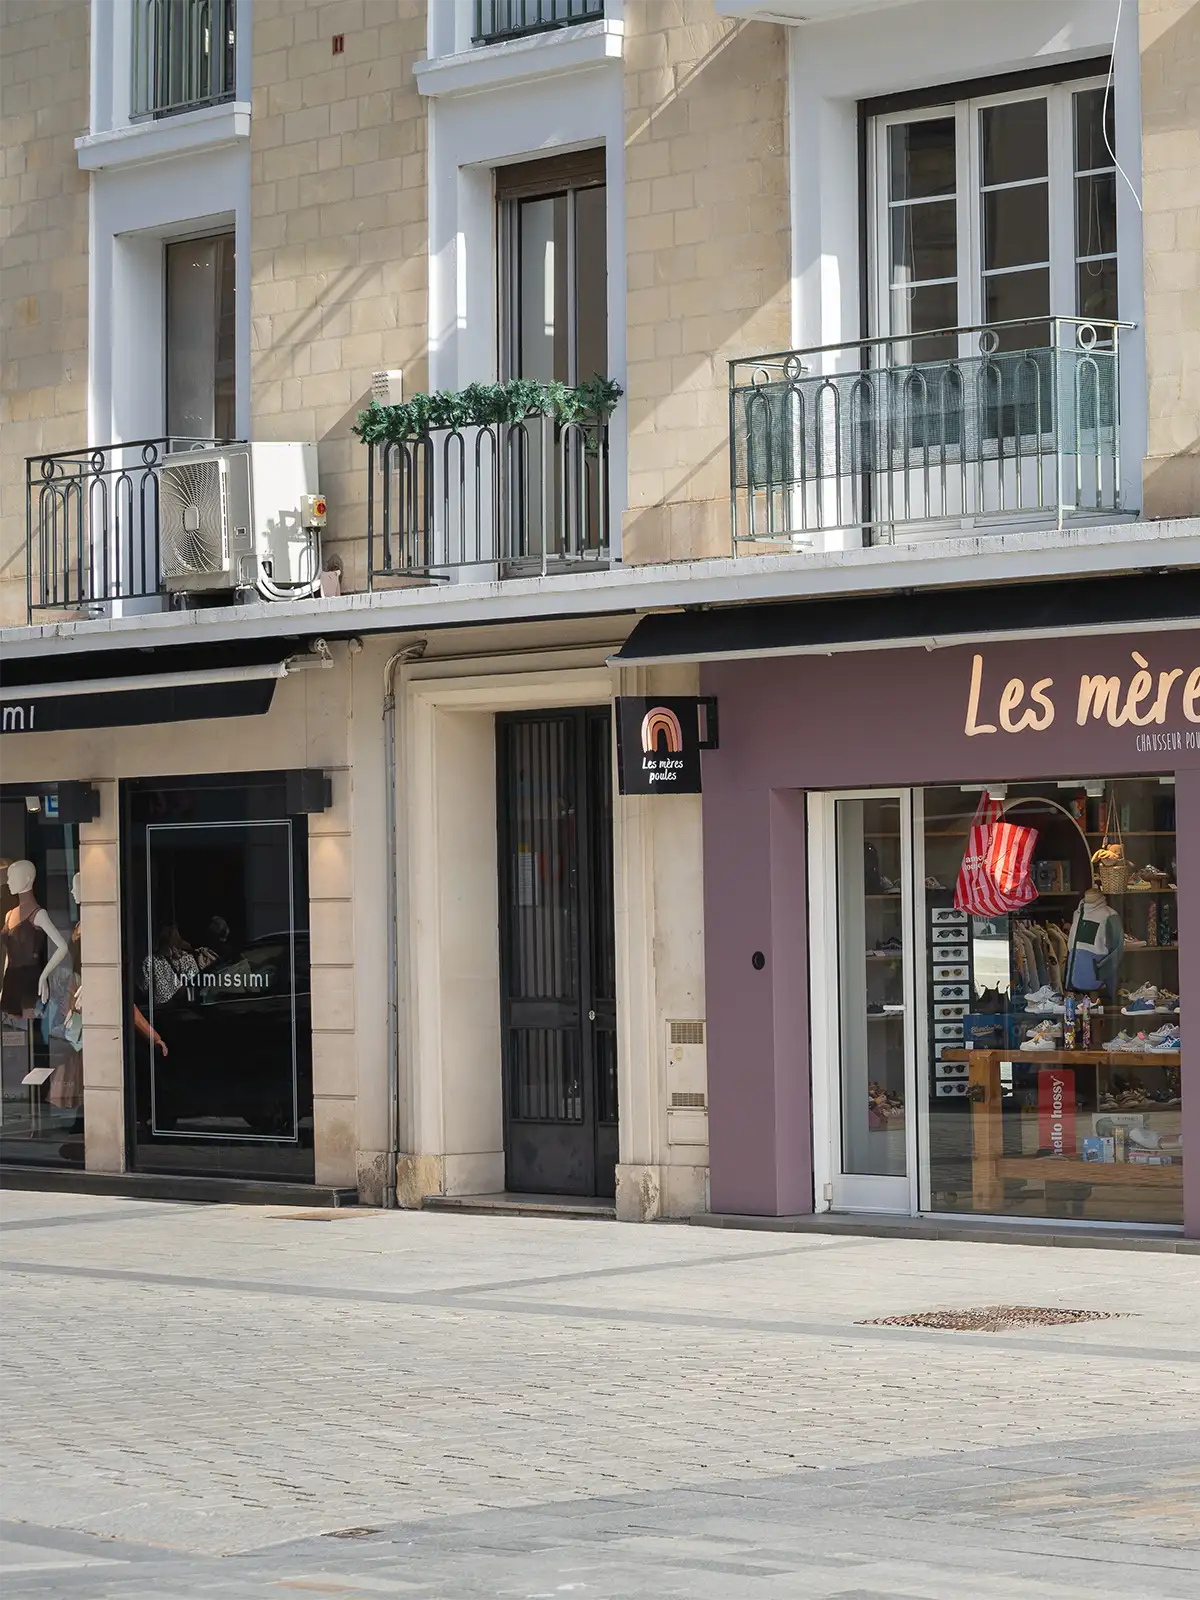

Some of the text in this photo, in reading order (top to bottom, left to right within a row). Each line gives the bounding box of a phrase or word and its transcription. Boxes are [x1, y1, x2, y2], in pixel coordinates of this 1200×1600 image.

[964, 653, 1056, 737] Les
[1136, 731, 1183, 752] CHAUSSEUR
[642, 756, 684, 769] Les mères
[648, 768, 677, 785] poules
[174, 971, 269, 987] intimissimi
[1050, 1077, 1065, 1119] hossy
